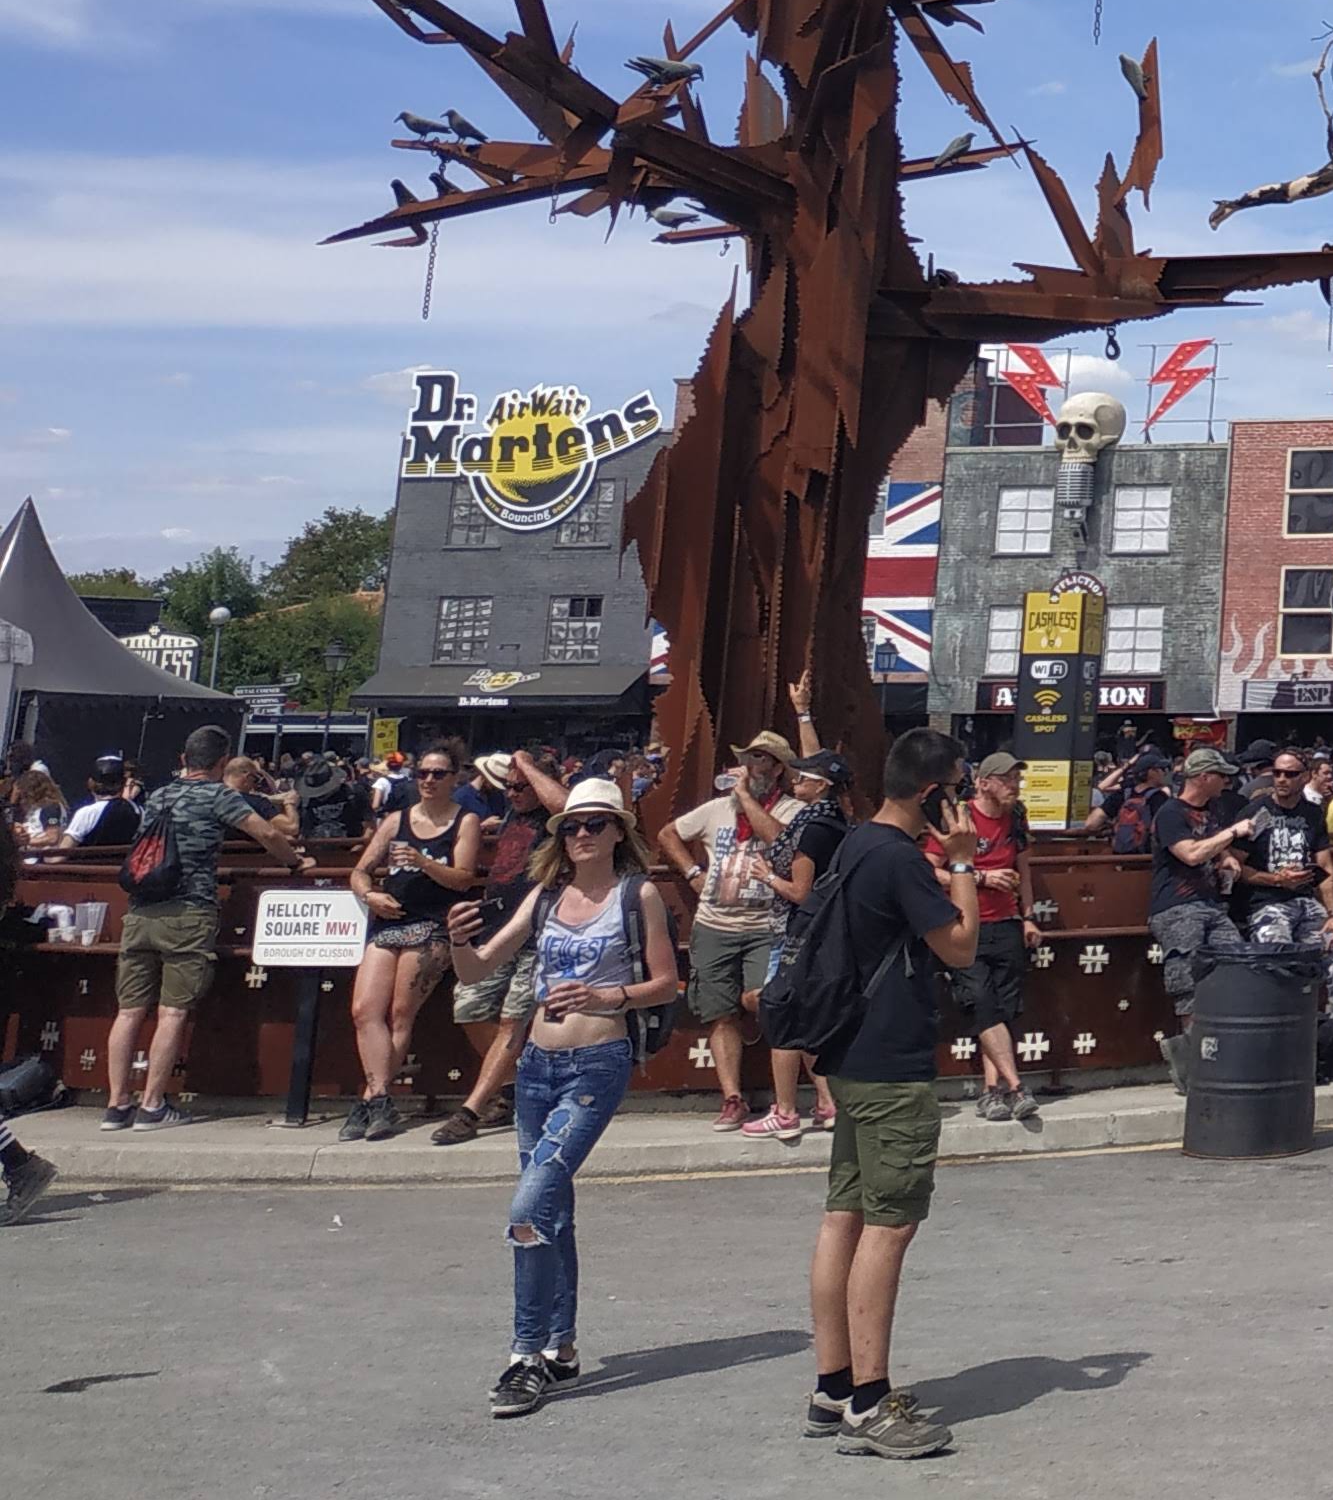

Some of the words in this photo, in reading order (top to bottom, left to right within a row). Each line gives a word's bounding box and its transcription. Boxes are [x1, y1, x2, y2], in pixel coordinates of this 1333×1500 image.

[411, 373, 476, 423] Dr.
[487, 388, 587, 427] AirWair
[404, 393, 660, 474] Martens
[501, 507, 552, 523] Bouncing
[1028, 611, 1078, 631] CASHLESS
[1024, 714, 1068, 722] CASHLESS
[1033, 725, 1057, 733] SPOT
[266, 903, 332, 918] HELLCITY
[264, 921, 320, 936] SQUARE
[324, 921, 358, 936] MW1
[263, 948, 304, 958] BOROUGH
[306, 948, 316, 958] OF
[318, 948, 354, 958] CLISSON
